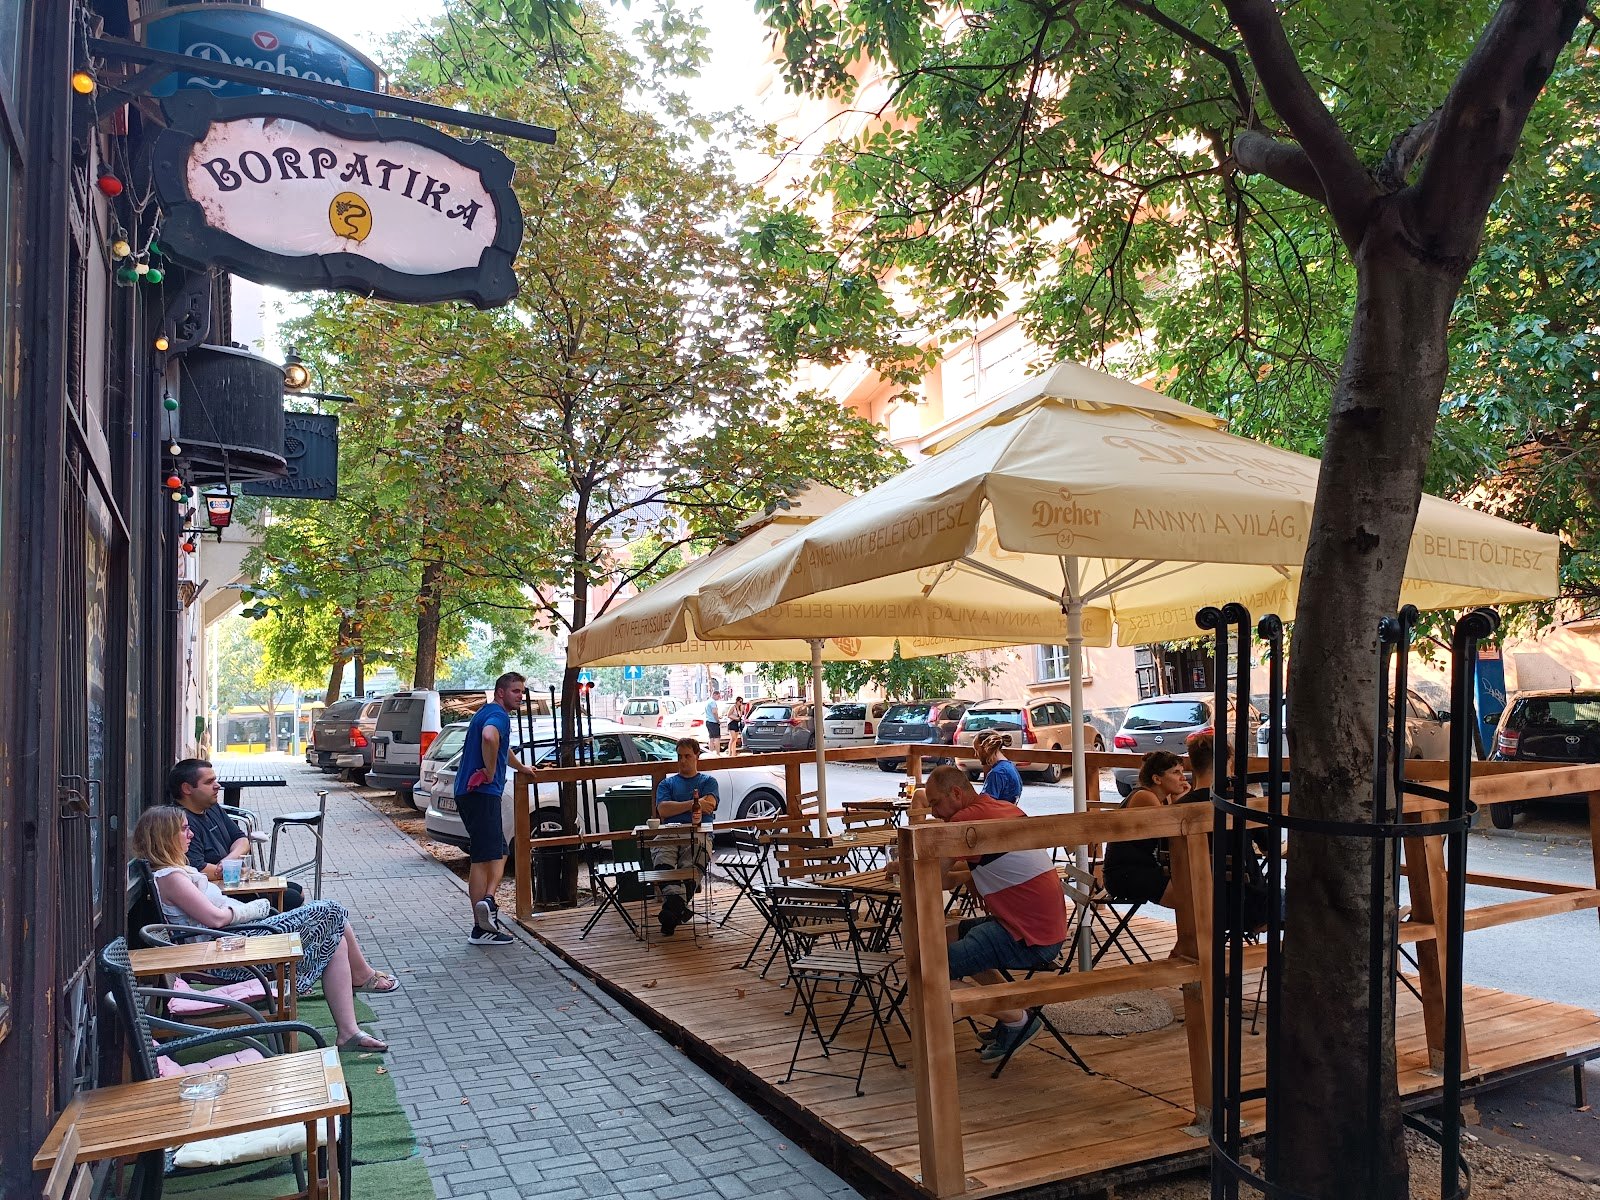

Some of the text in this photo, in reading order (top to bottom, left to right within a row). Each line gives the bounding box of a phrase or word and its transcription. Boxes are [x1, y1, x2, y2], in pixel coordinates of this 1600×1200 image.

[202, 147, 484, 231] BORPATIKA
[284, 418, 336, 442] PATIKA
[256, 477, 335, 491] RPATIKA
[869, 502, 970, 554] BELETÖLTESZ
[1031, 500, 1102, 529] Dreher
[1132, 508, 1206, 533] ANNYI
[1214, 513, 1231, 535] A
[1238, 510, 1303, 542] VILÁG,
[1424, 533, 1542, 571] BELETÖLTESZ
